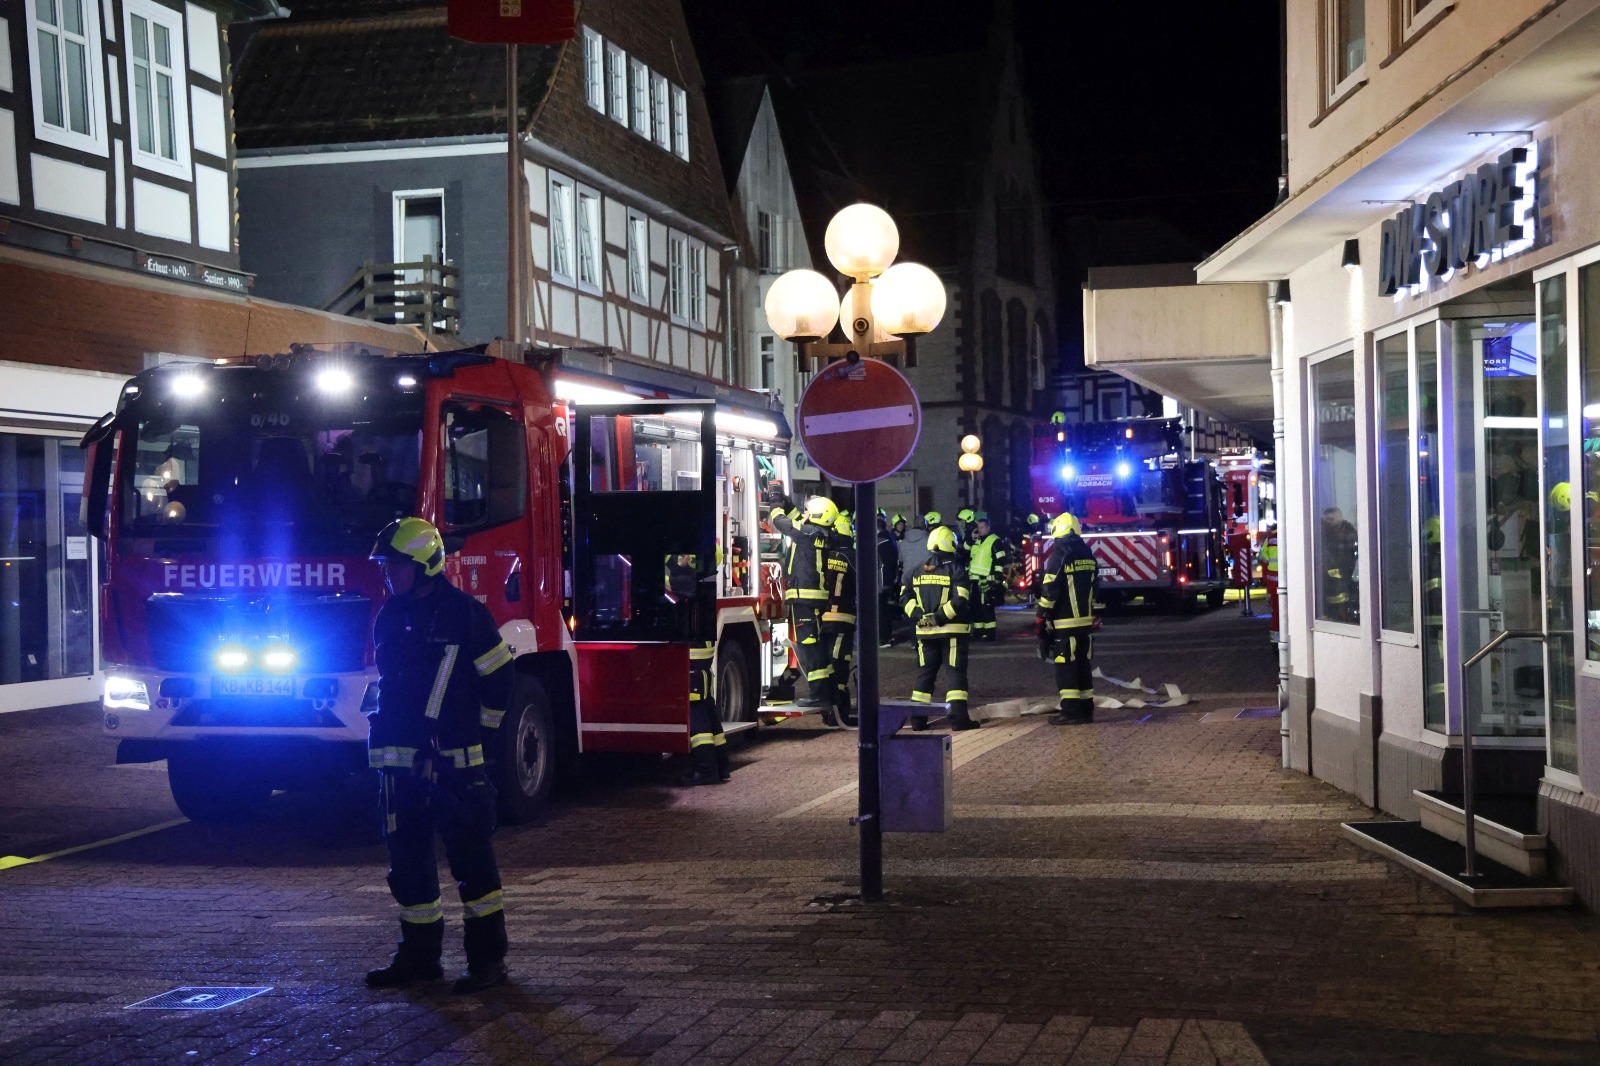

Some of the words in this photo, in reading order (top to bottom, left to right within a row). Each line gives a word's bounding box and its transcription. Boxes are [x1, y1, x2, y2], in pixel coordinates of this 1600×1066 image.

[147, 258, 168, 274] Erbaut
[461, 555, 487, 565] FEUERWEHR
[164, 563, 346, 588] FEUERWEHR
